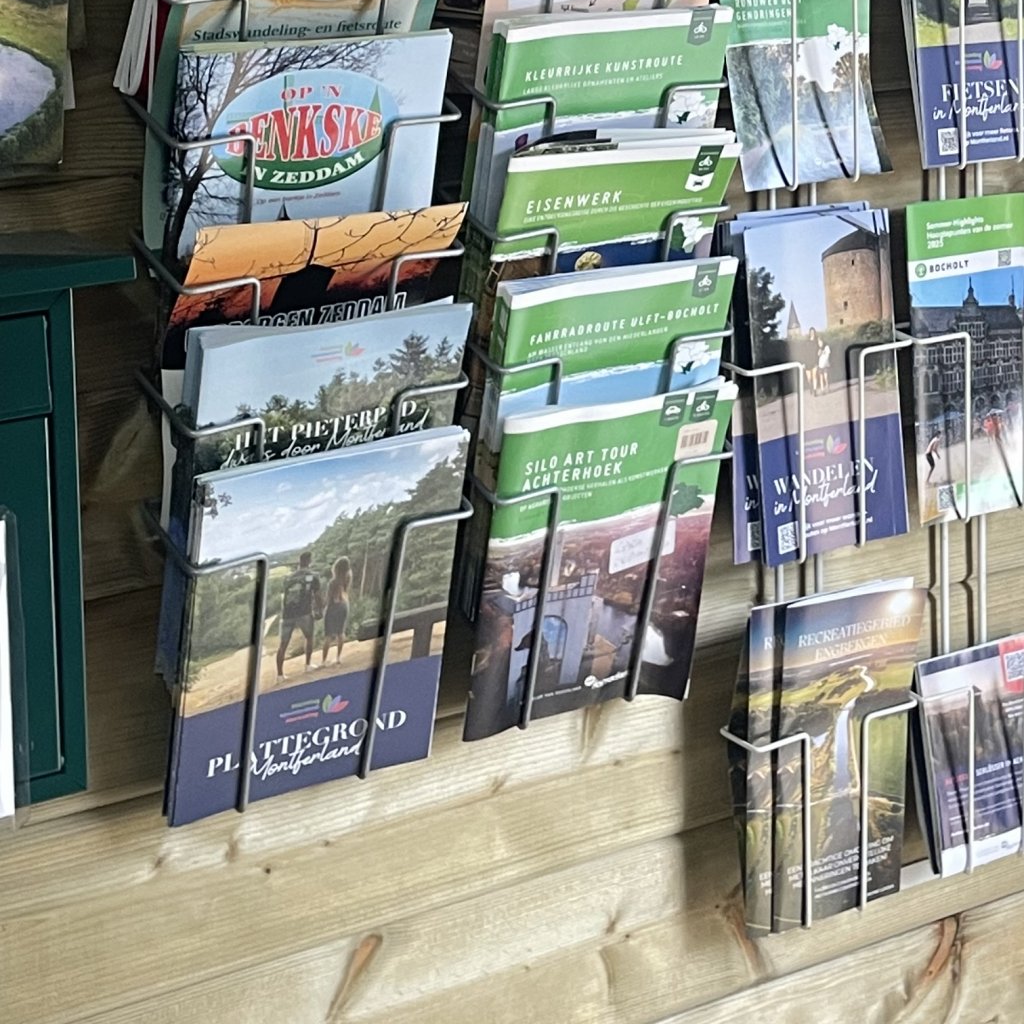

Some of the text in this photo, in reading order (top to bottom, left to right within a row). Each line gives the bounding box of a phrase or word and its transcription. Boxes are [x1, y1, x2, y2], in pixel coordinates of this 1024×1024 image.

[314, 23, 332, 34] en
[524, 54, 684, 83] KLEURRIJKE KUNSTROUTE
[280, 85, 313, 101] OP
[932, 106, 947, 121] in
[270, 150, 366, 185] ZEDDAM
[525, 189, 623, 215] EISENWERK
[929, 259, 970, 273] BOCHOLT
[529, 302, 721, 347] FAHRRADROUTE ULFT-BOCHOLT
[291, 400, 418, 440] PIETERPD
[524, 441, 640, 476] SILO ART TOUR
[521, 460, 624, 493] ACHTERHOEK
[798, 615, 912, 648] RECREATIEGEBIED
